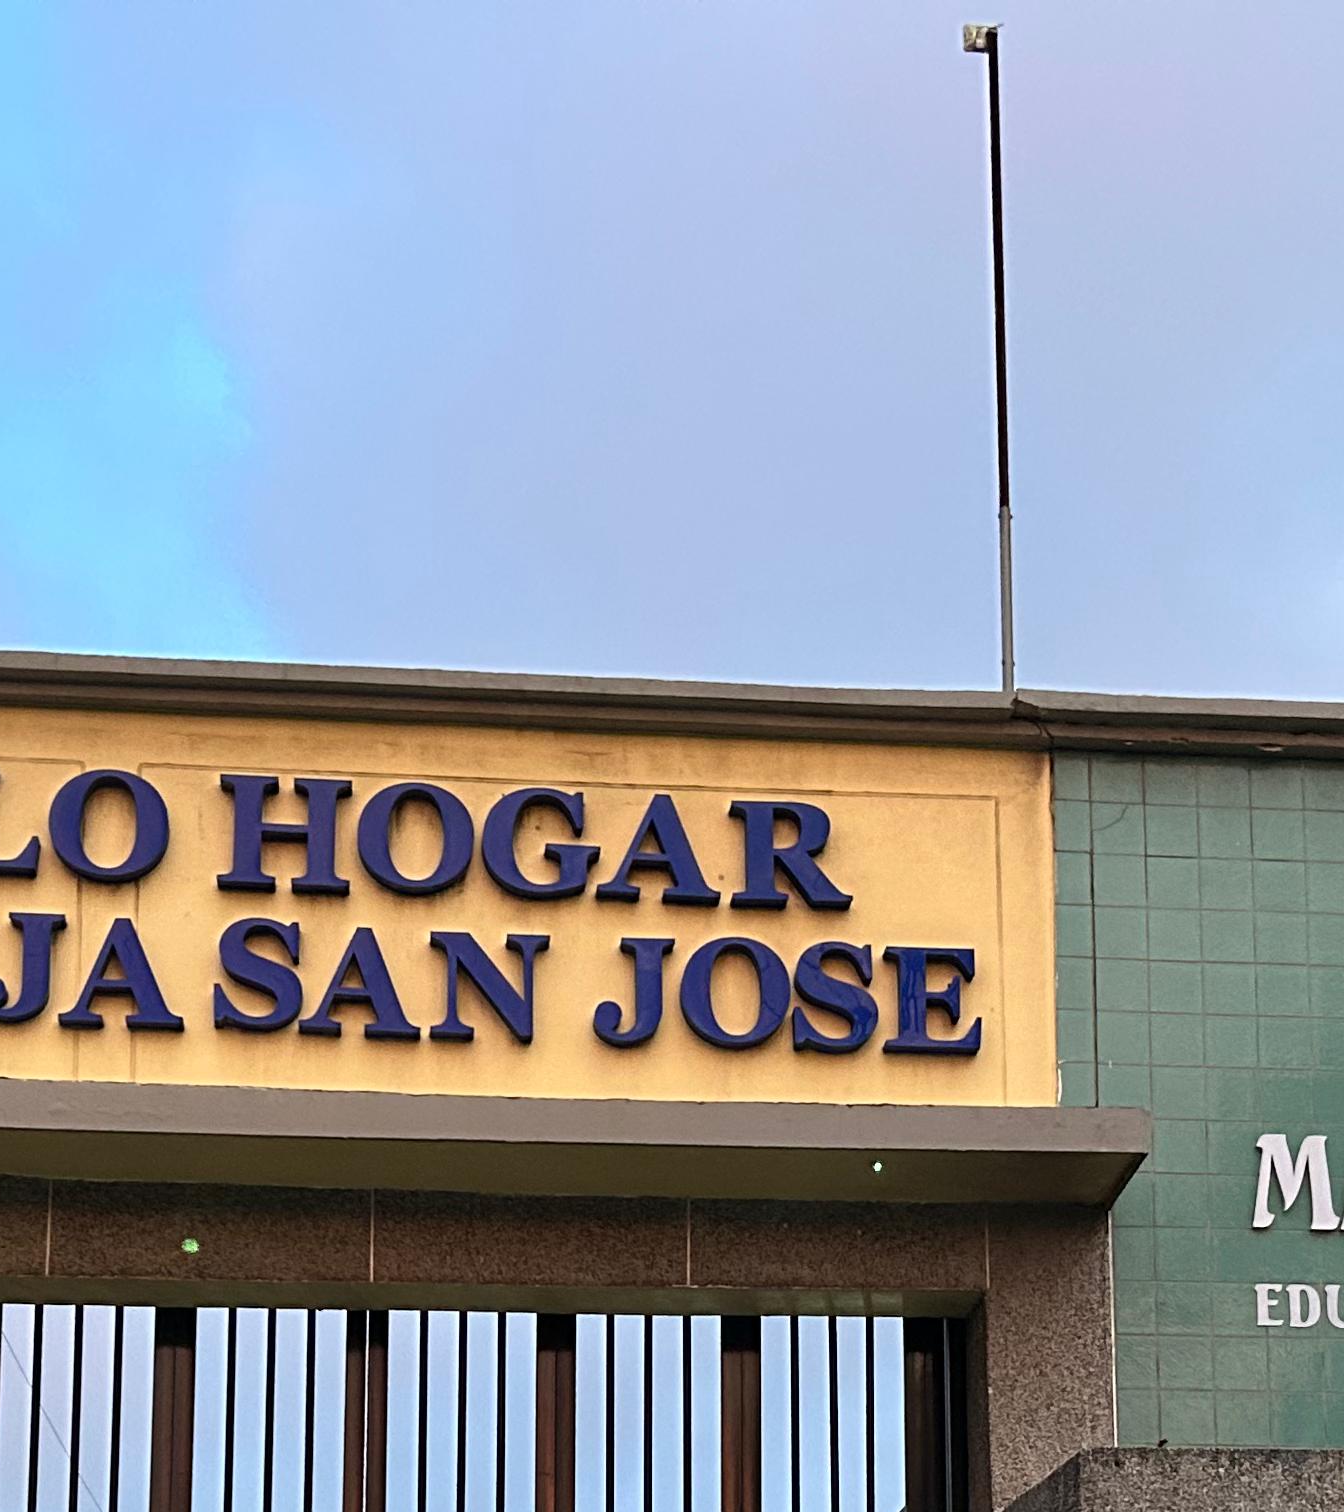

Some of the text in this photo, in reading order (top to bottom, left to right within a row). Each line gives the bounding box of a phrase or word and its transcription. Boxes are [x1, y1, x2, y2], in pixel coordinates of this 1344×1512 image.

[217, 774, 853, 914] HOGAR
[213, 917, 550, 1047] SAN
[592, 937, 981, 1058] JOSE
